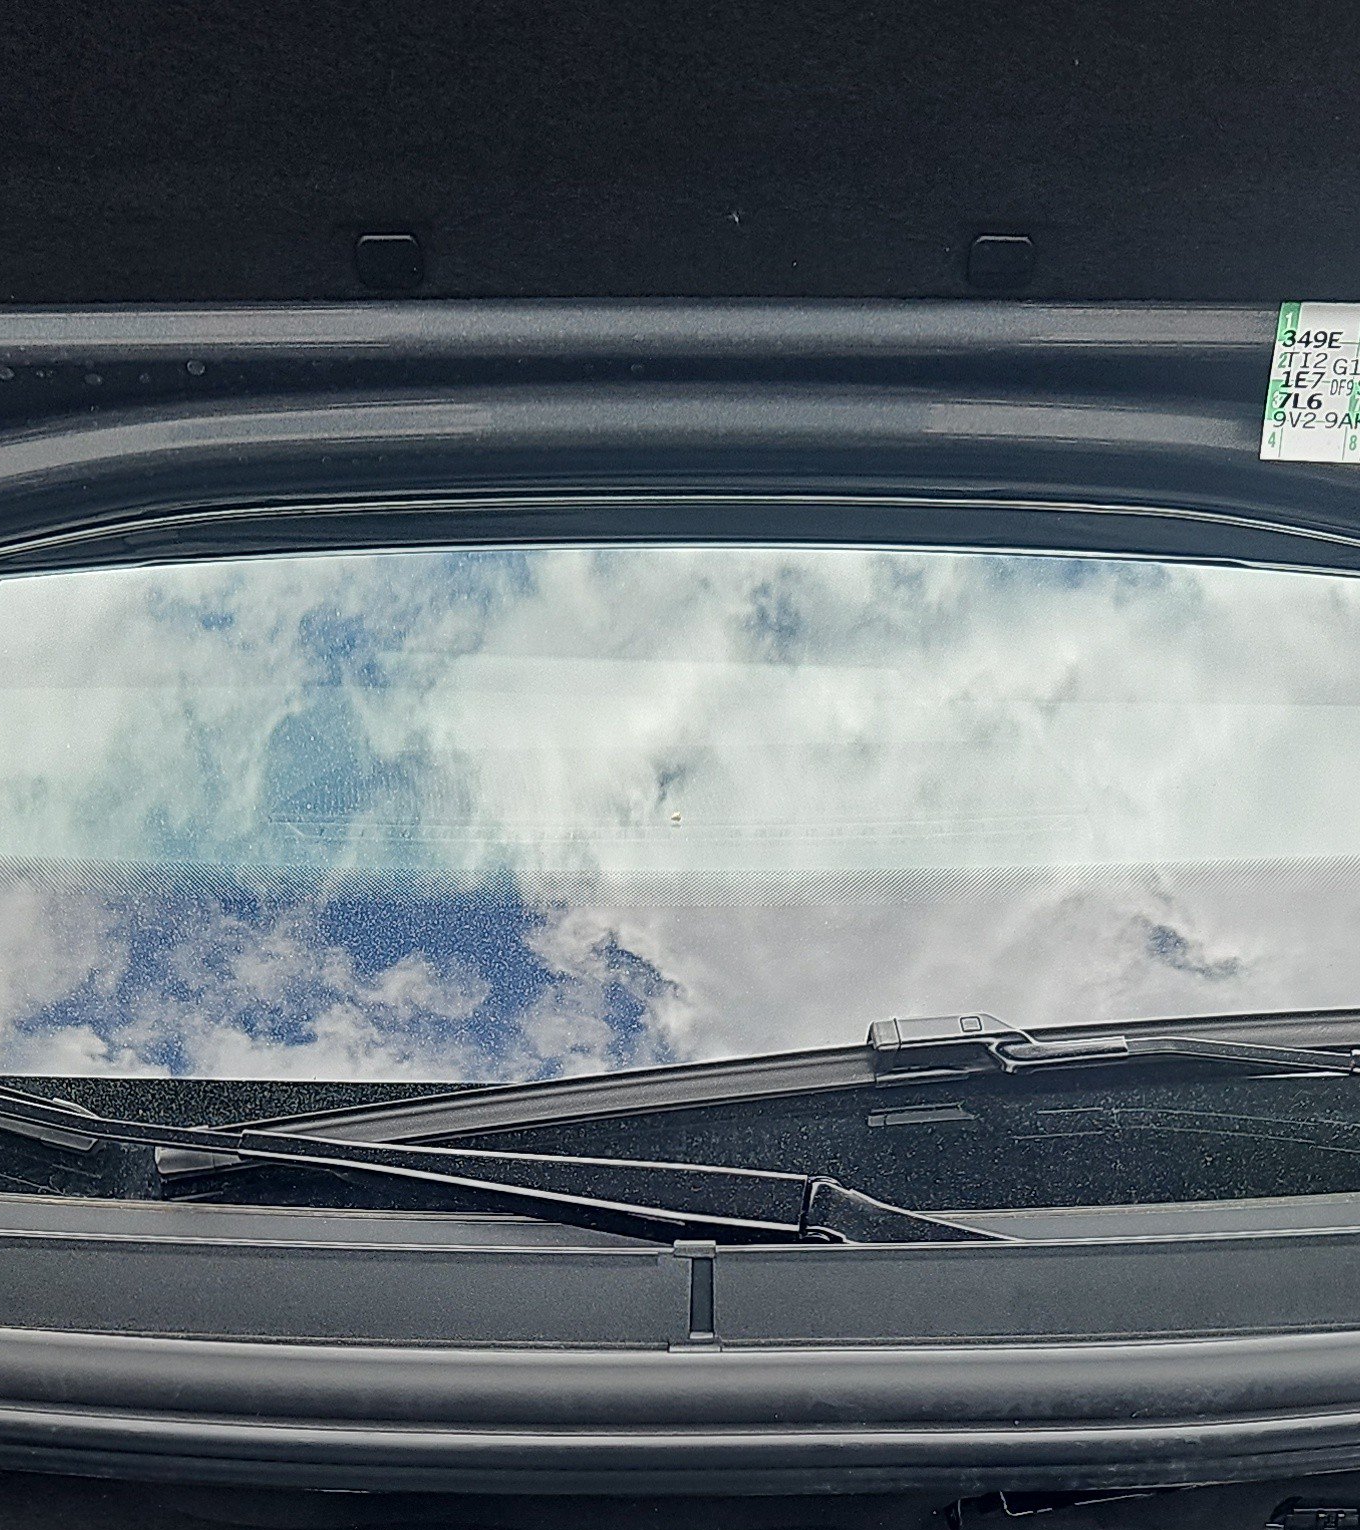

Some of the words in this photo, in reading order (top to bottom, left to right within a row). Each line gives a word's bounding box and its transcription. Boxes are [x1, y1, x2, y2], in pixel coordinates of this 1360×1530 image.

[1281, 331, 1343, 350] 349E
[1281, 372, 1324, 389] 1E7
[1330, 379, 1354, 396] DF9
[1276, 393, 1323, 411] 7L6
[1273, 412, 1316, 429] 9V2
[1267, 432, 1276, 448] 4
[1349, 435, 1358, 451] 8
